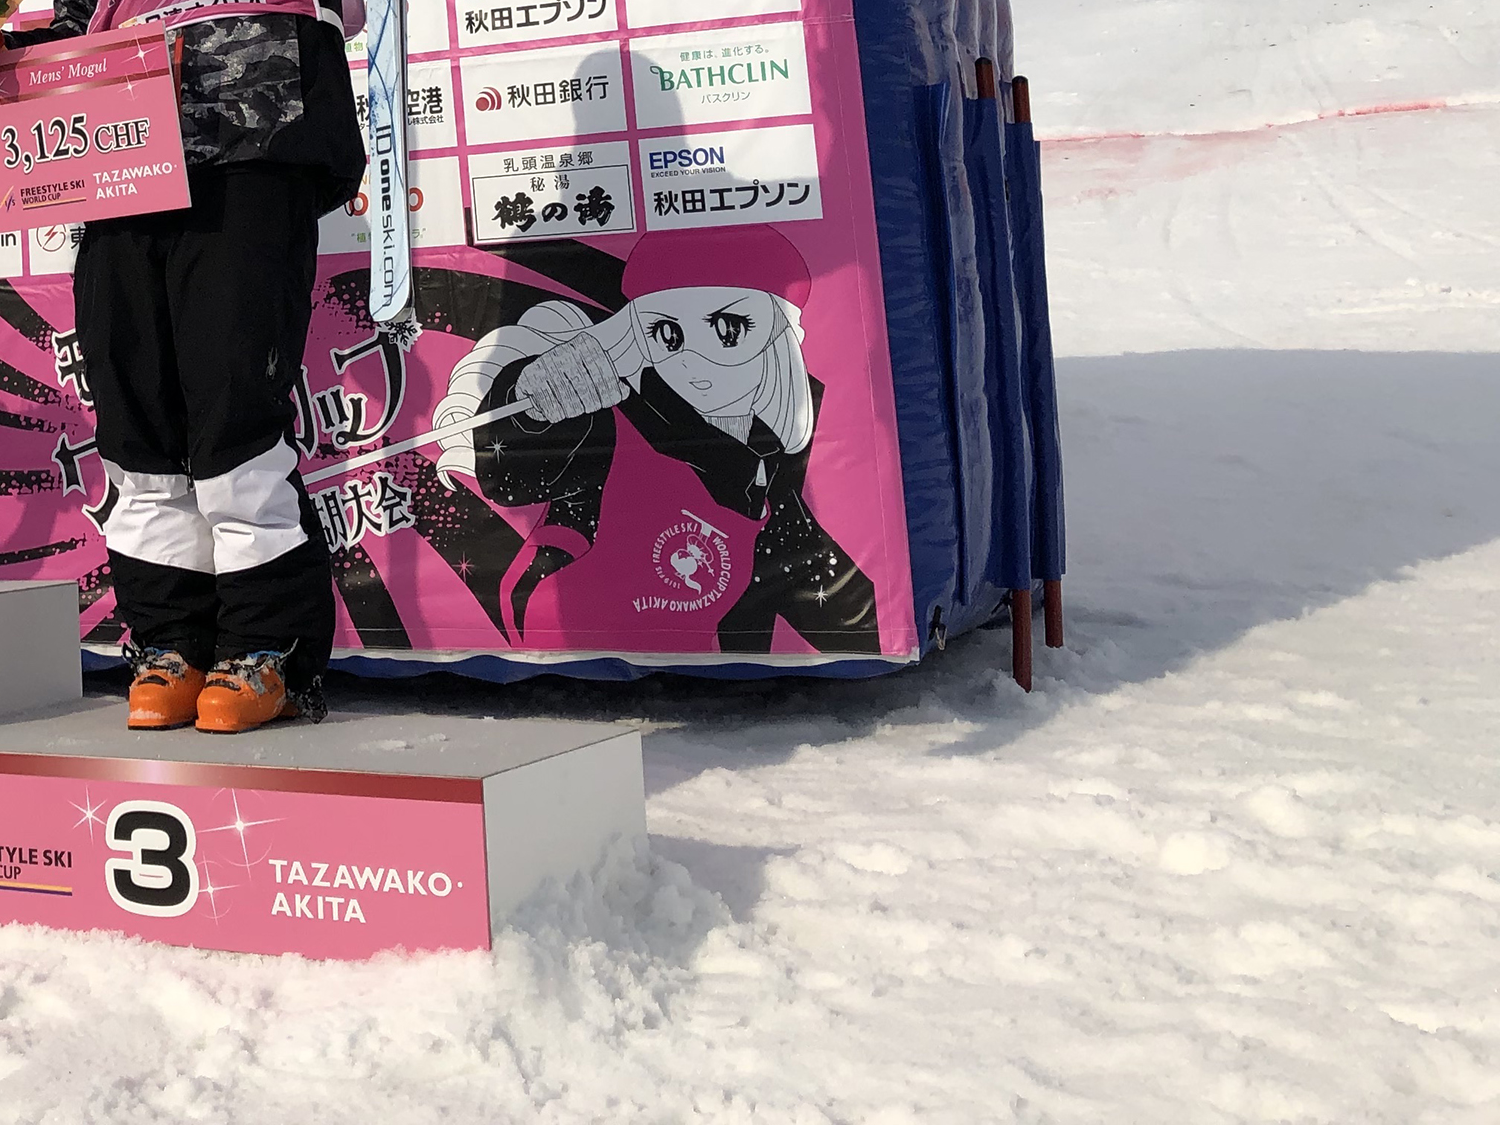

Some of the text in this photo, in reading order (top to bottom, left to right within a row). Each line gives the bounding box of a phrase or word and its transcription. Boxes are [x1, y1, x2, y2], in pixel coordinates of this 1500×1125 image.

[68, 58, 108, 81] Mogul
[650, 58, 789, 92] BATHCLIN
[507, 75, 609, 109] 秋田銀行
[701, 91, 751, 104] バスクリン
[2, 113, 150, 174] 3,125 CHF
[502, 150, 594, 174] 乳頭温泉郷
[648, 146, 725, 171] EPSON
[650, 170, 678, 178] EXCEED
[700, 165, 726, 174] VISION
[20, 179, 85, 198] FREESTYLE SKI
[22, 191, 61, 205] WORLD CUP
[95, 183, 138, 200] AKITA
[654, 179, 811, 217] 秋田エプソン
[680, 522, 698, 534] SKI
[632, 594, 669, 613] AKITA
[669, 583, 722, 612] TAZAWAKO
[41, 847, 73, 868] SKI
[109, 805, 194, 912] 3
[270, 895, 367, 924] AKITA
